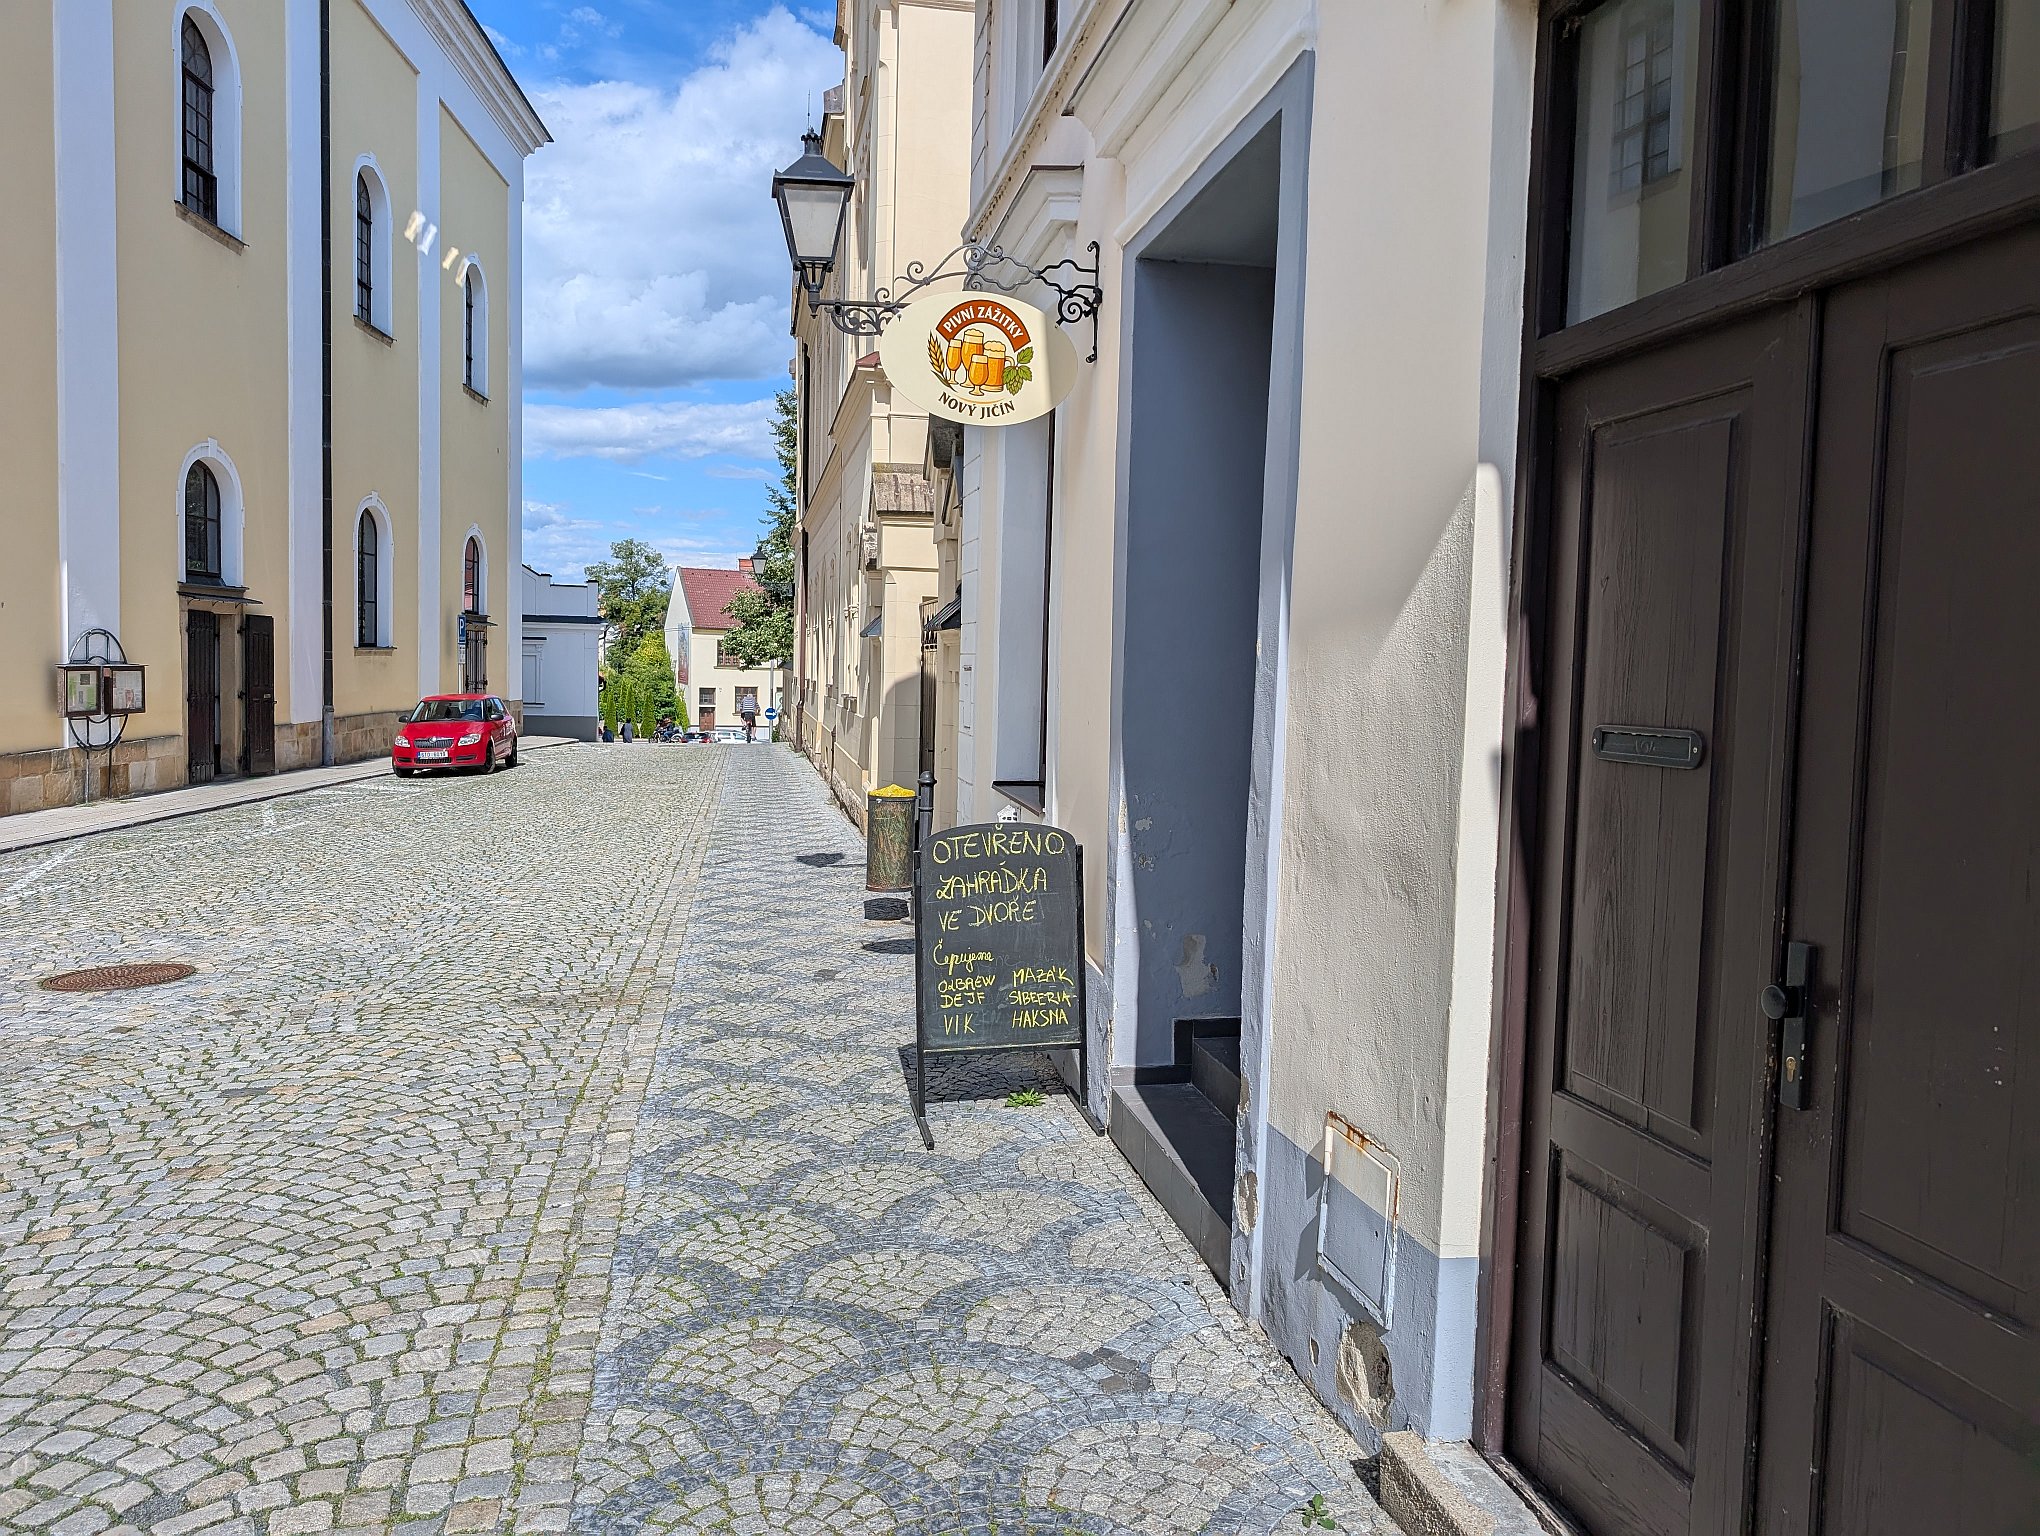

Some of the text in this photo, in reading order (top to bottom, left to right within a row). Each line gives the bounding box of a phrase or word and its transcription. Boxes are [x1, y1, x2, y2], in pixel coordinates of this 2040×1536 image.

[943, 305, 1024, 340] PIVNÍ ZÁŽITKY
[938, 391, 1016, 420] NOVÝ JIČÍN
[459, 618, 465, 635] P
[932, 824, 1065, 864] OTEVŘENO
[936, 860, 1048, 899] ZAHRÁDKA
[938, 895, 1037, 933] VE DVOŘE
[933, 938, 994, 976] Čepujeme
[943, 1013, 975, 1036] VIK
